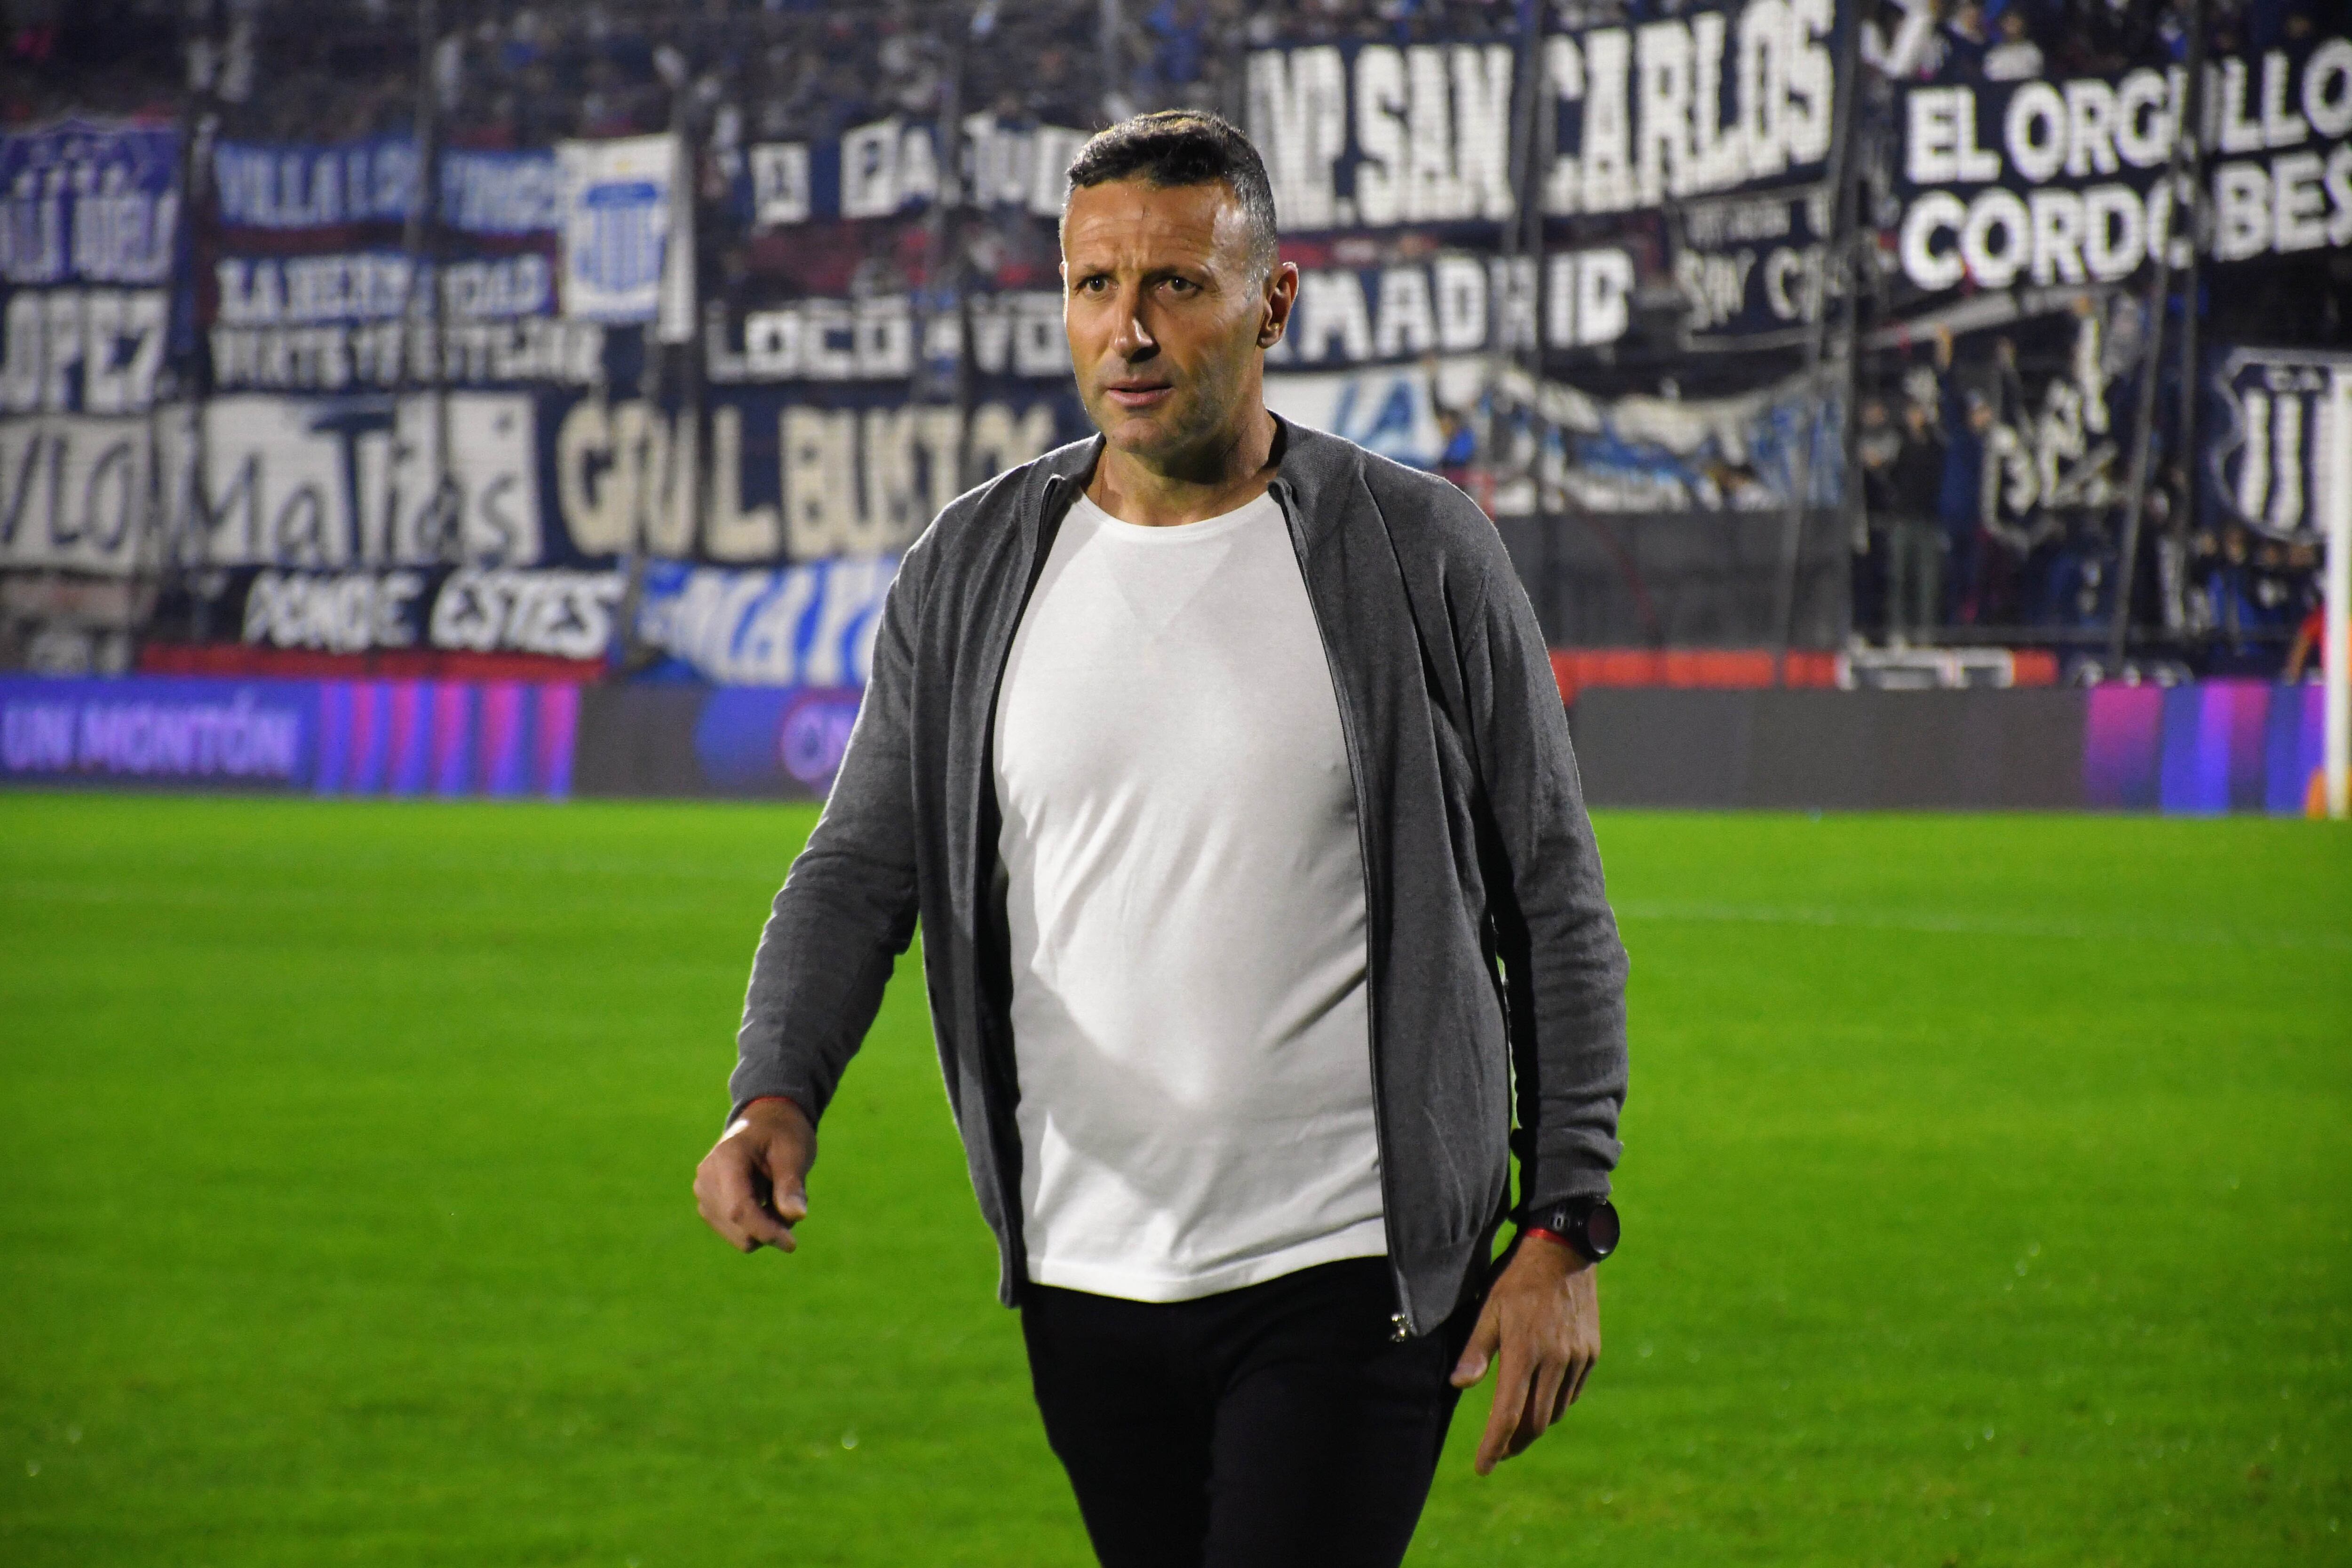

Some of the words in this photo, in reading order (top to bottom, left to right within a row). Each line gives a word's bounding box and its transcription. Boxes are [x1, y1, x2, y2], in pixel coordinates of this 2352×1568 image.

[1356, 42, 1518, 228] SAN
[1539, 0, 1836, 216] CARLOS
[1906, 86, 2003, 183] EL
[0, 287, 168, 415] OPEZ
[704, 294, 915, 380] LOCO
[969, 292, 1073, 375] VO
[1265, 247, 1636, 366] MADRID
[4, 703, 70, 772] UN
[80, 685, 299, 776] MONTÓN
